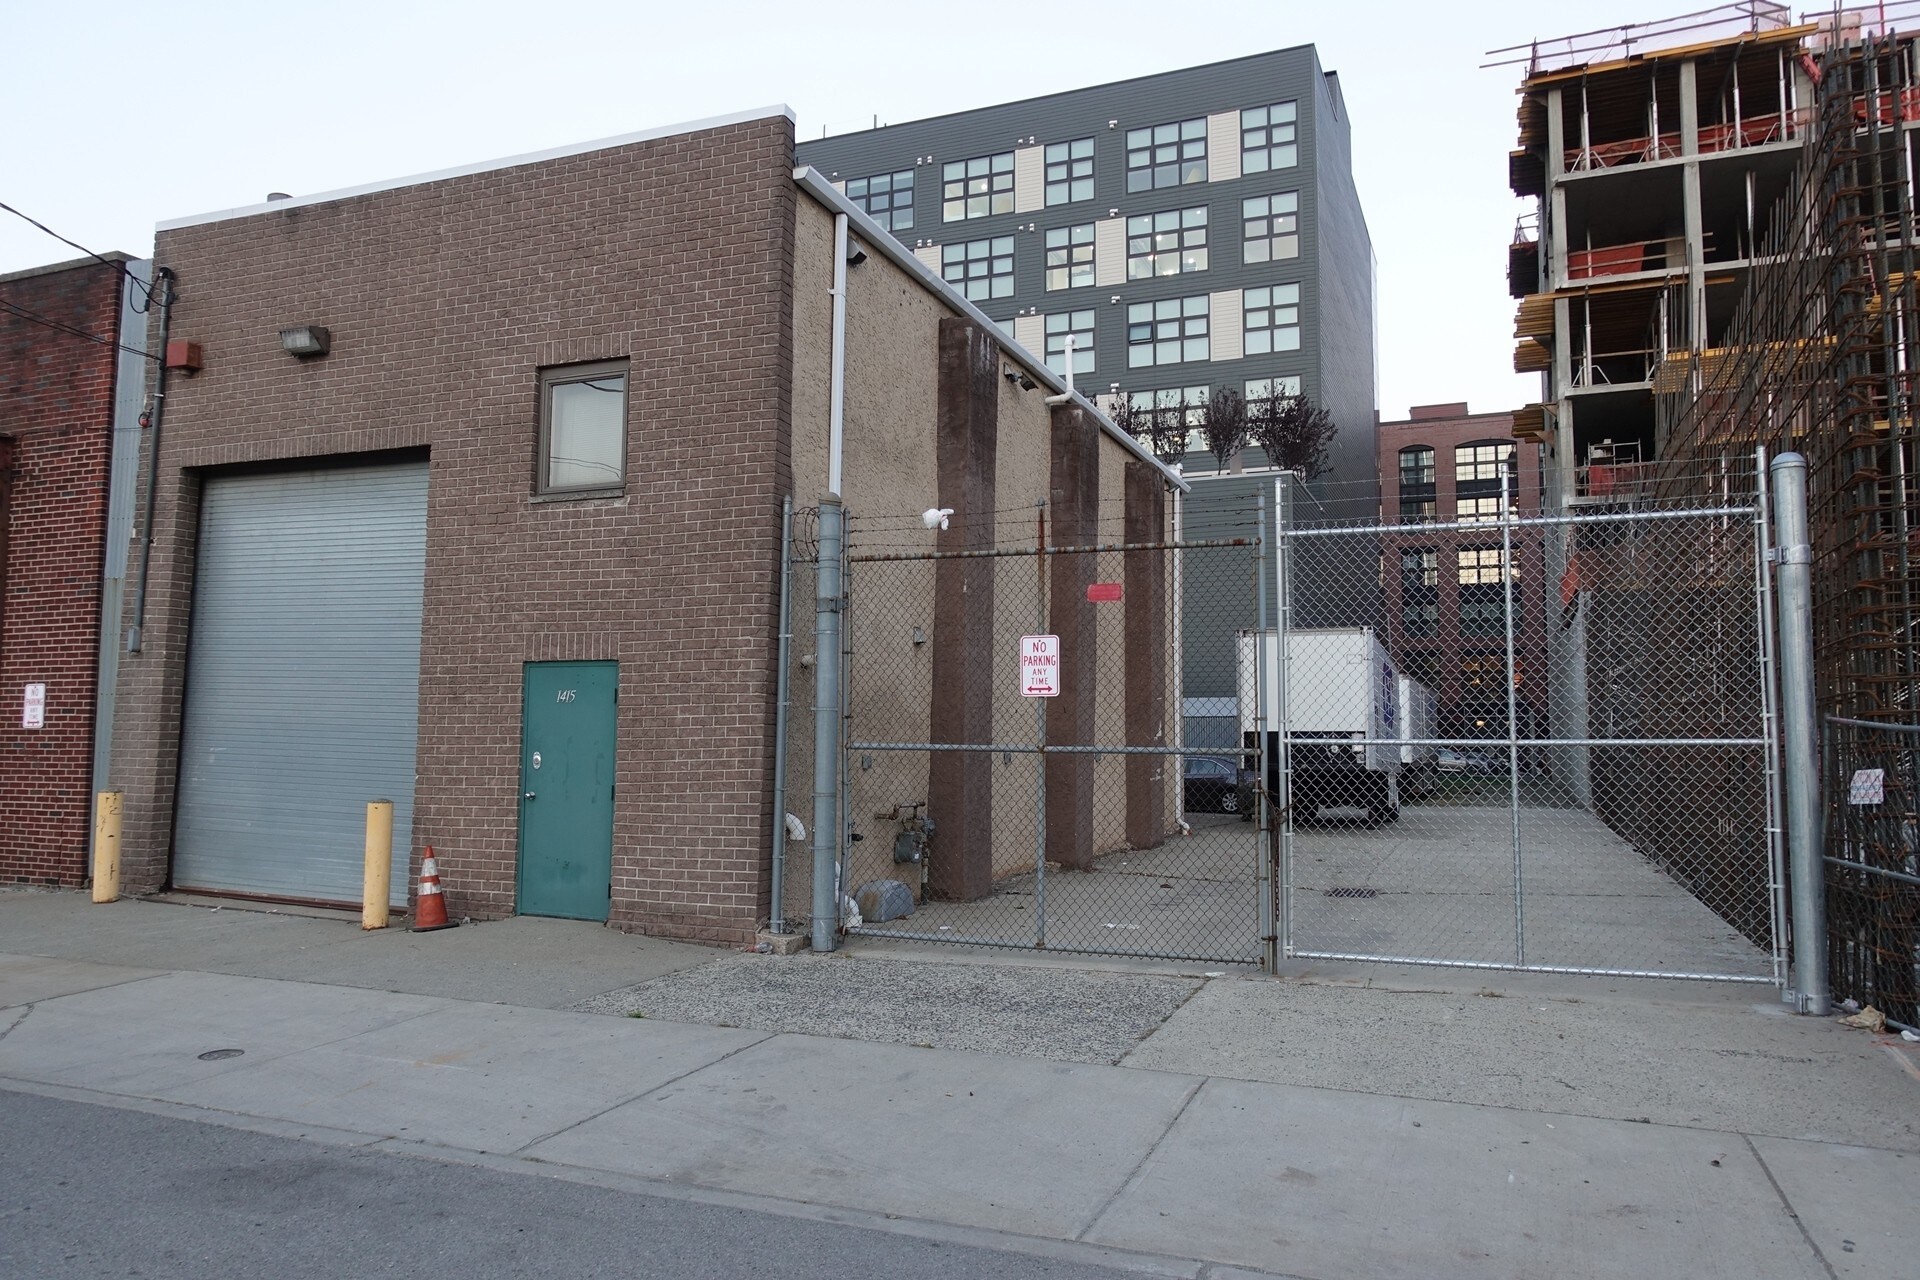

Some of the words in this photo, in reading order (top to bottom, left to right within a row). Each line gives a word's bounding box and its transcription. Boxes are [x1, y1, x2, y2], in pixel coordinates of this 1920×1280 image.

[1032, 641, 1047, 653] NO
[1023, 655, 1056, 667] PARKING
[1032, 668, 1047, 676] ANY
[1031, 677, 1049, 685] TIME
[556, 689, 577, 703] 1415
